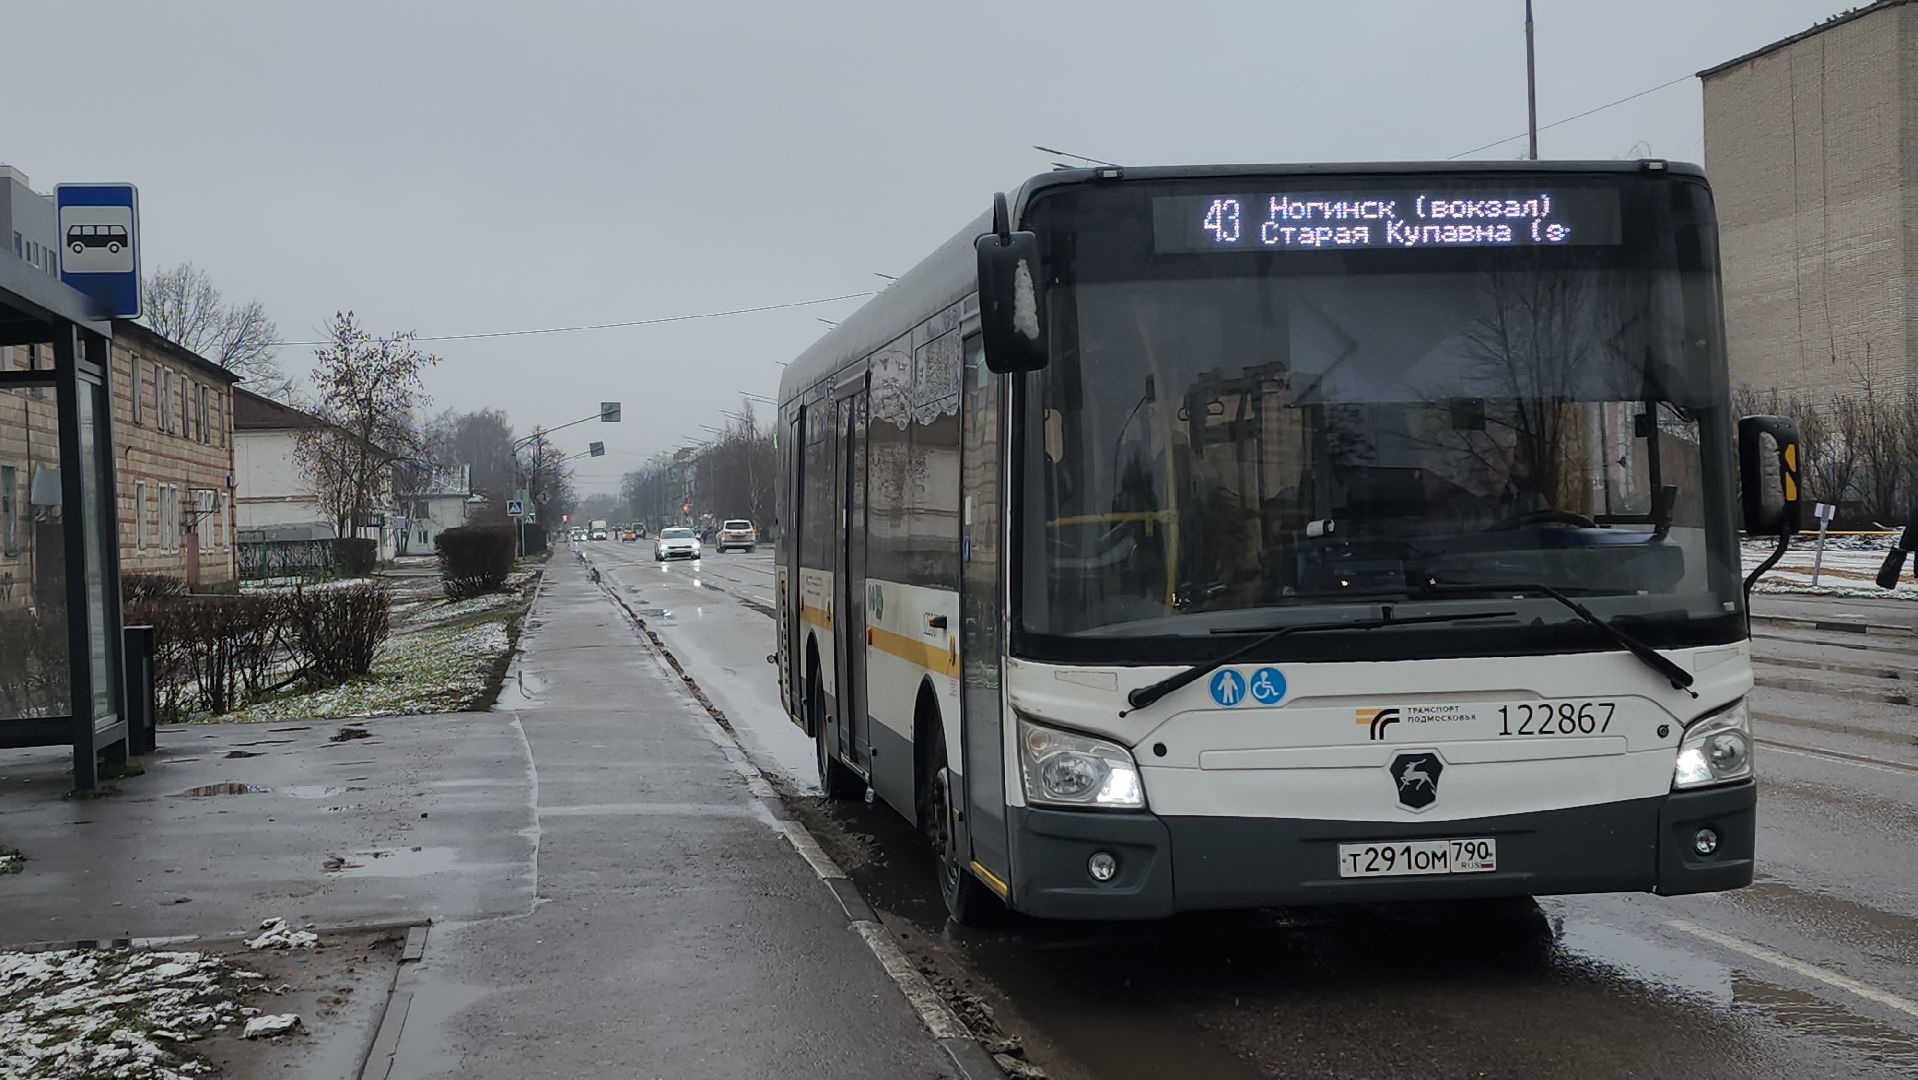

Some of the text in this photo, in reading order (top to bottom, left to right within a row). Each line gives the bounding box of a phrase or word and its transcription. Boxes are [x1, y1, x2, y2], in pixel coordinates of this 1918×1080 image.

[1270, 194, 1550, 220] Ногинск (вокзал)
[1203, 199, 1240, 242] 43
[1261, 221, 1370, 246] Старая
[1387, 219, 1512, 246] Купавна
[1407, 705, 1461, 714] ТРАНСПОРТ
[1407, 714, 1477, 723] ПОДМОСКОВЬЯ
[1497, 702, 1616, 736] 122867
[1451, 841, 1489, 862] 790
[1460, 861, 1480, 870] RUS
